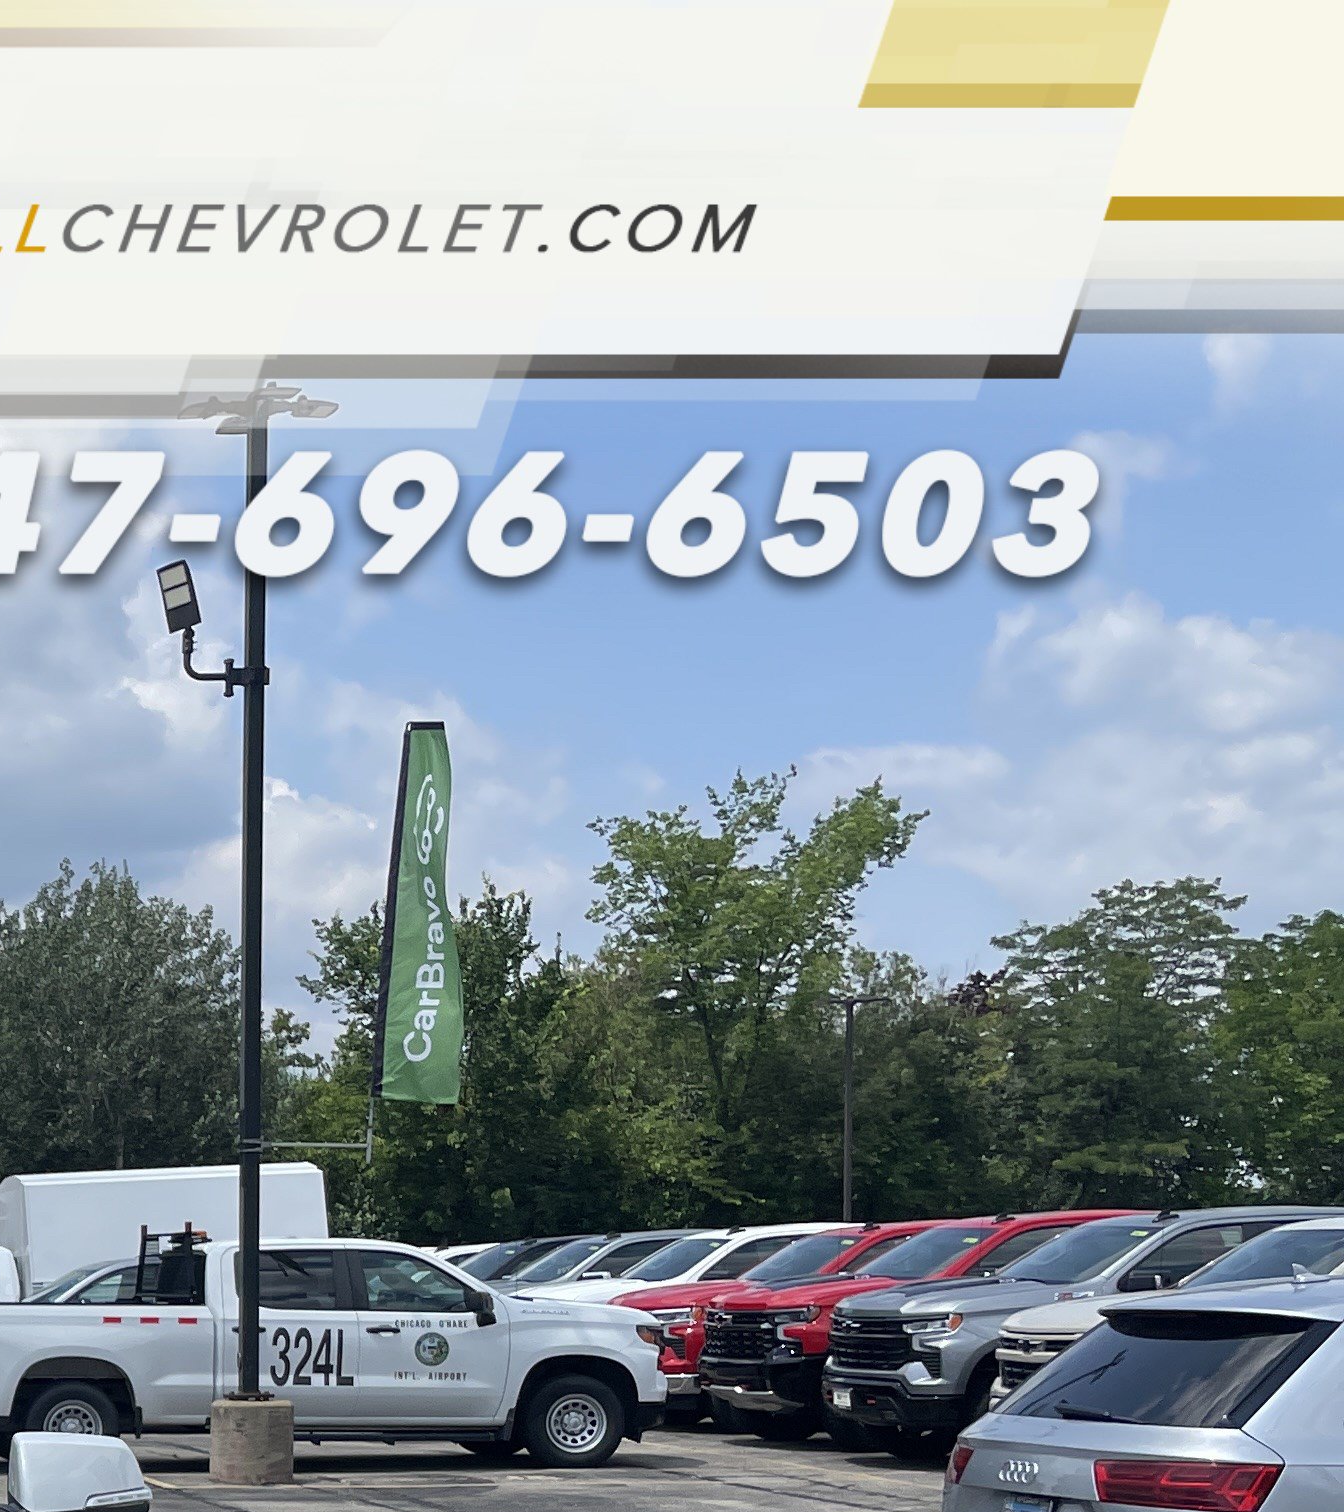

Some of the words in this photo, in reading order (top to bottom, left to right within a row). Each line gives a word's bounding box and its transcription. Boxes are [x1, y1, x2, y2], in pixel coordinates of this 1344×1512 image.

[403, 876, 445, 1062] CarBravo
[395, 1319, 432, 1329] CHICAGO
[270, 1327, 354, 1387] 324L
